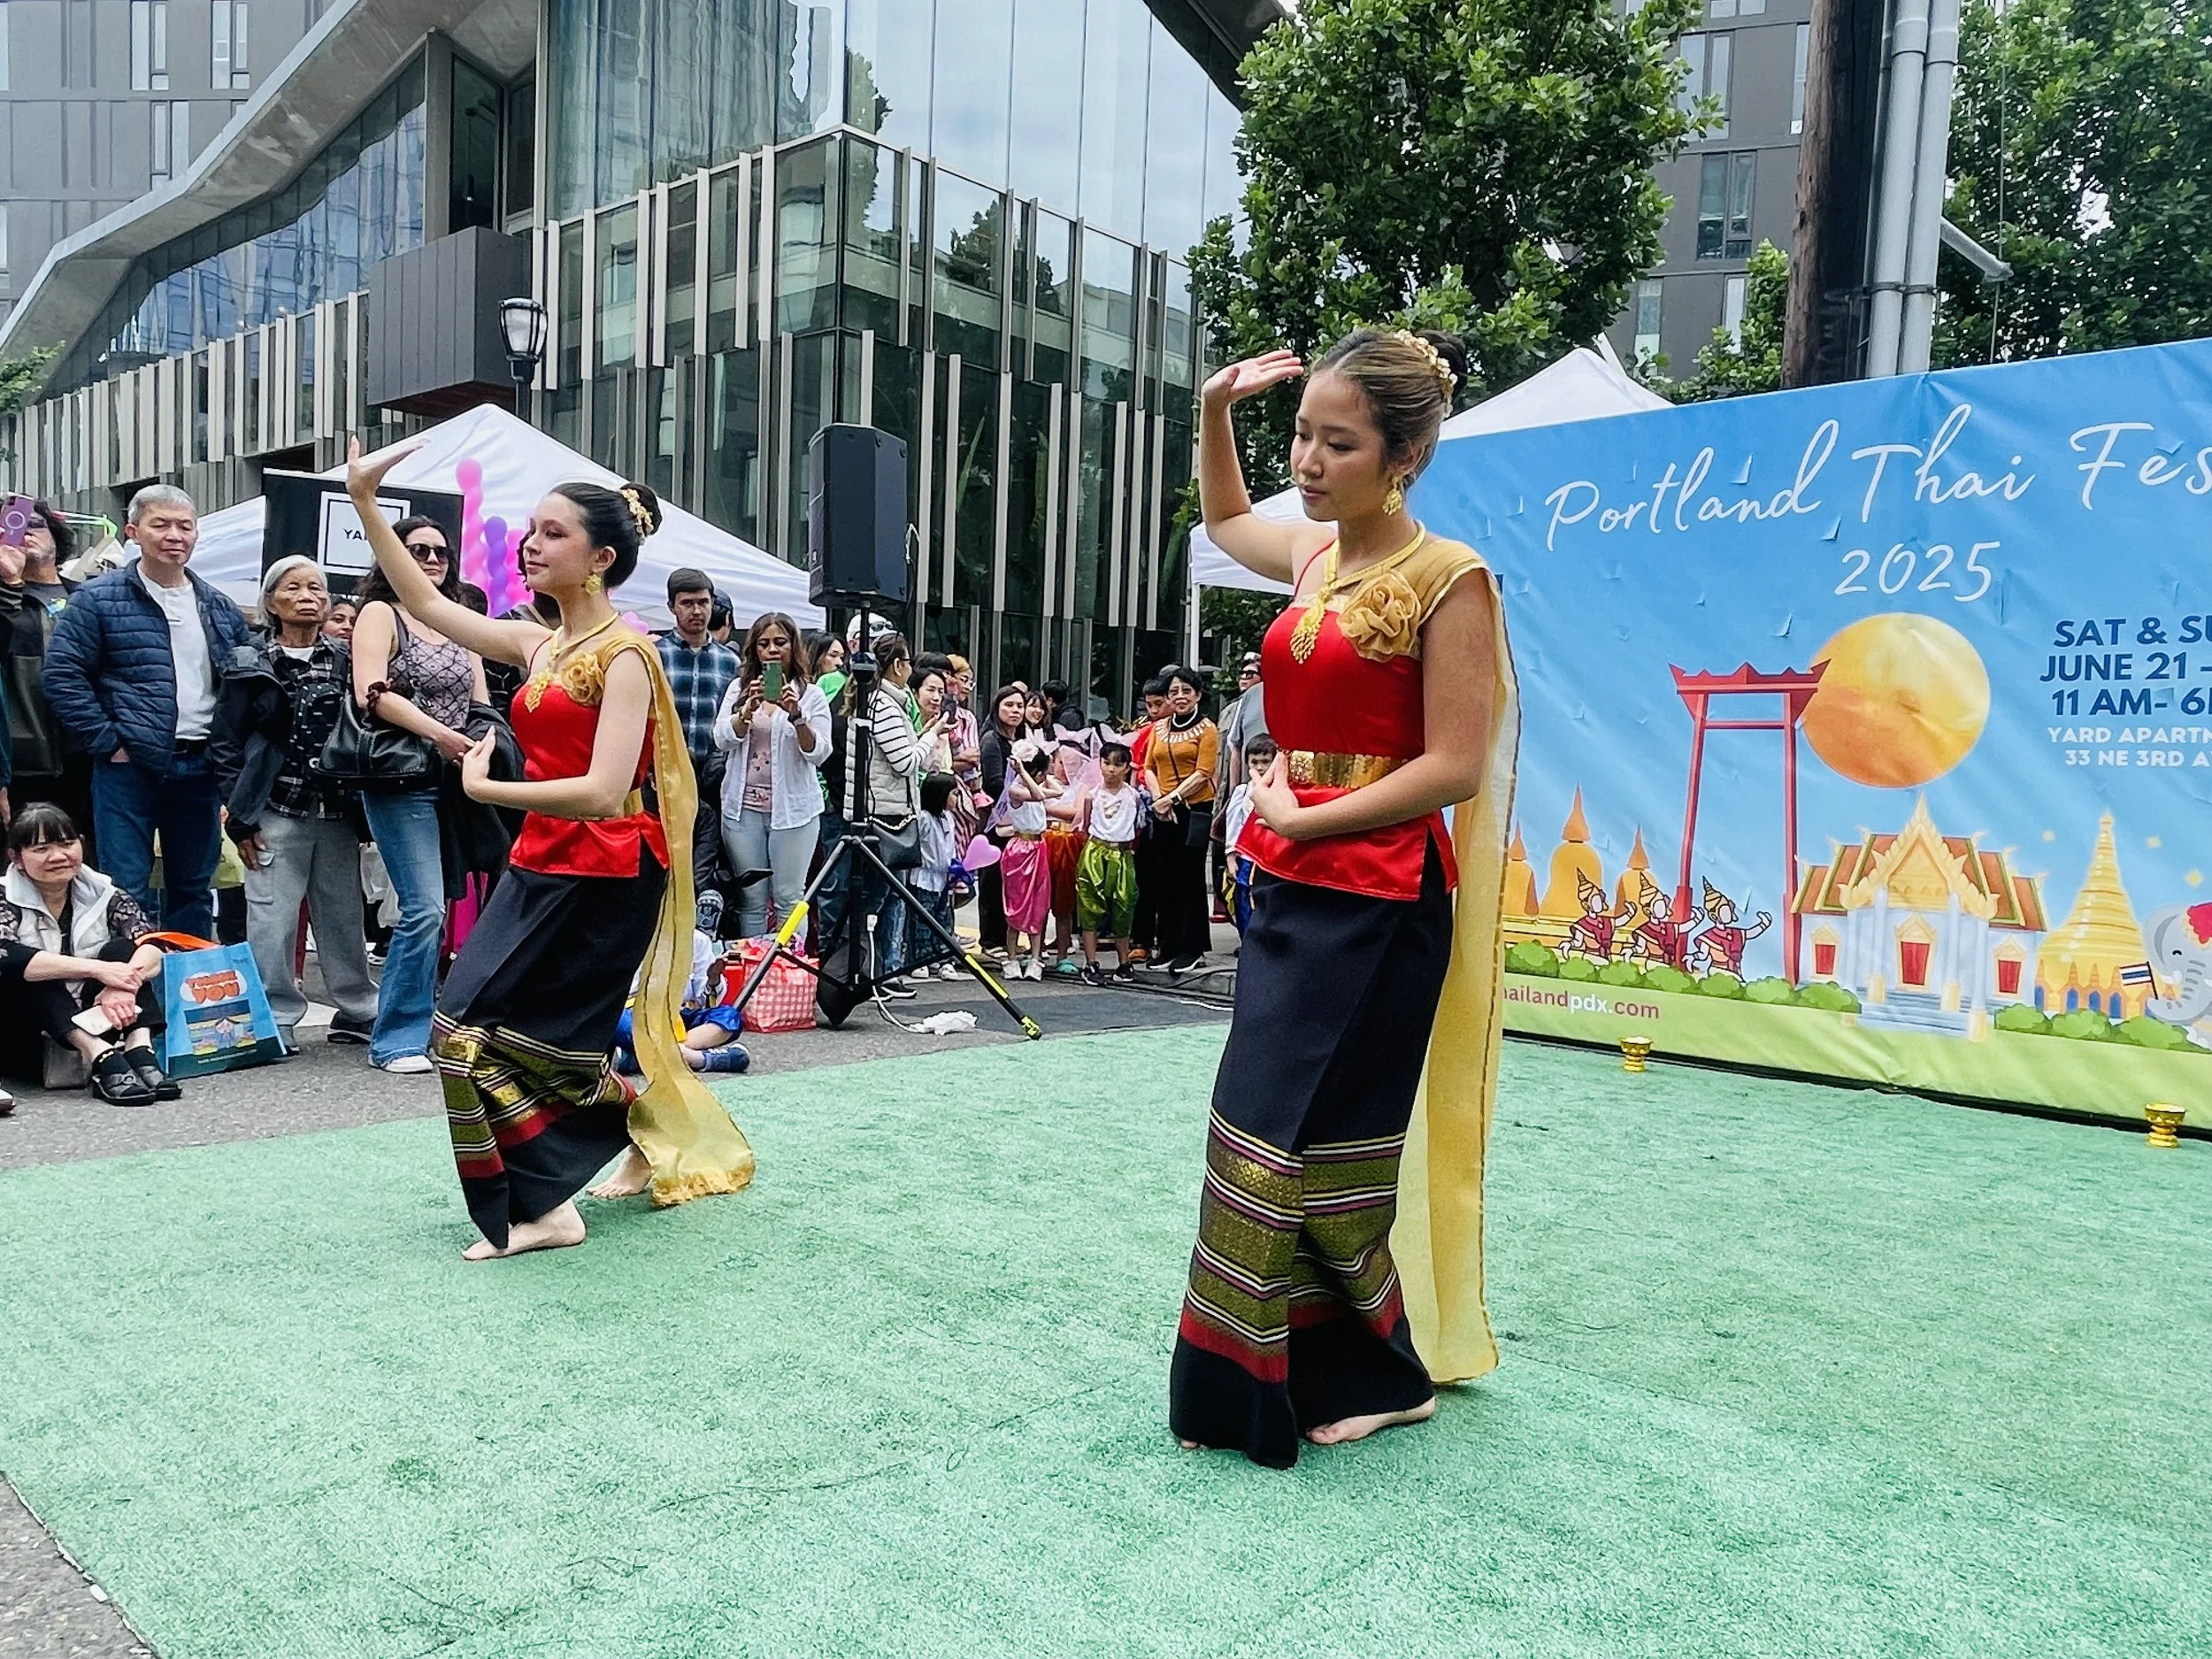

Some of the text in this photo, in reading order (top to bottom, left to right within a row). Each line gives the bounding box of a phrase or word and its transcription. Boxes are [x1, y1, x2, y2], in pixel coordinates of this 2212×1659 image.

[1545, 419, 1839, 552] Portland
[1851, 403, 2036, 523] Thai
[343, 528, 368, 541] YA
[1834, 541, 2001, 602] 2025
[2053, 618, 2127, 648] SAT
[2136, 617, 2168, 645] &
[2039, 653, 2133, 682] JUNE
[2145, 651, 2187, 680] 21
[2052, 688, 2079, 716] 11
[2180, 687, 2212, 716] 6
[2047, 726, 2111, 743] YARD
[2065, 749, 2212, 767] 33 NE 3RD A
[1503, 985, 1660, 1018] ailandpdx.com
